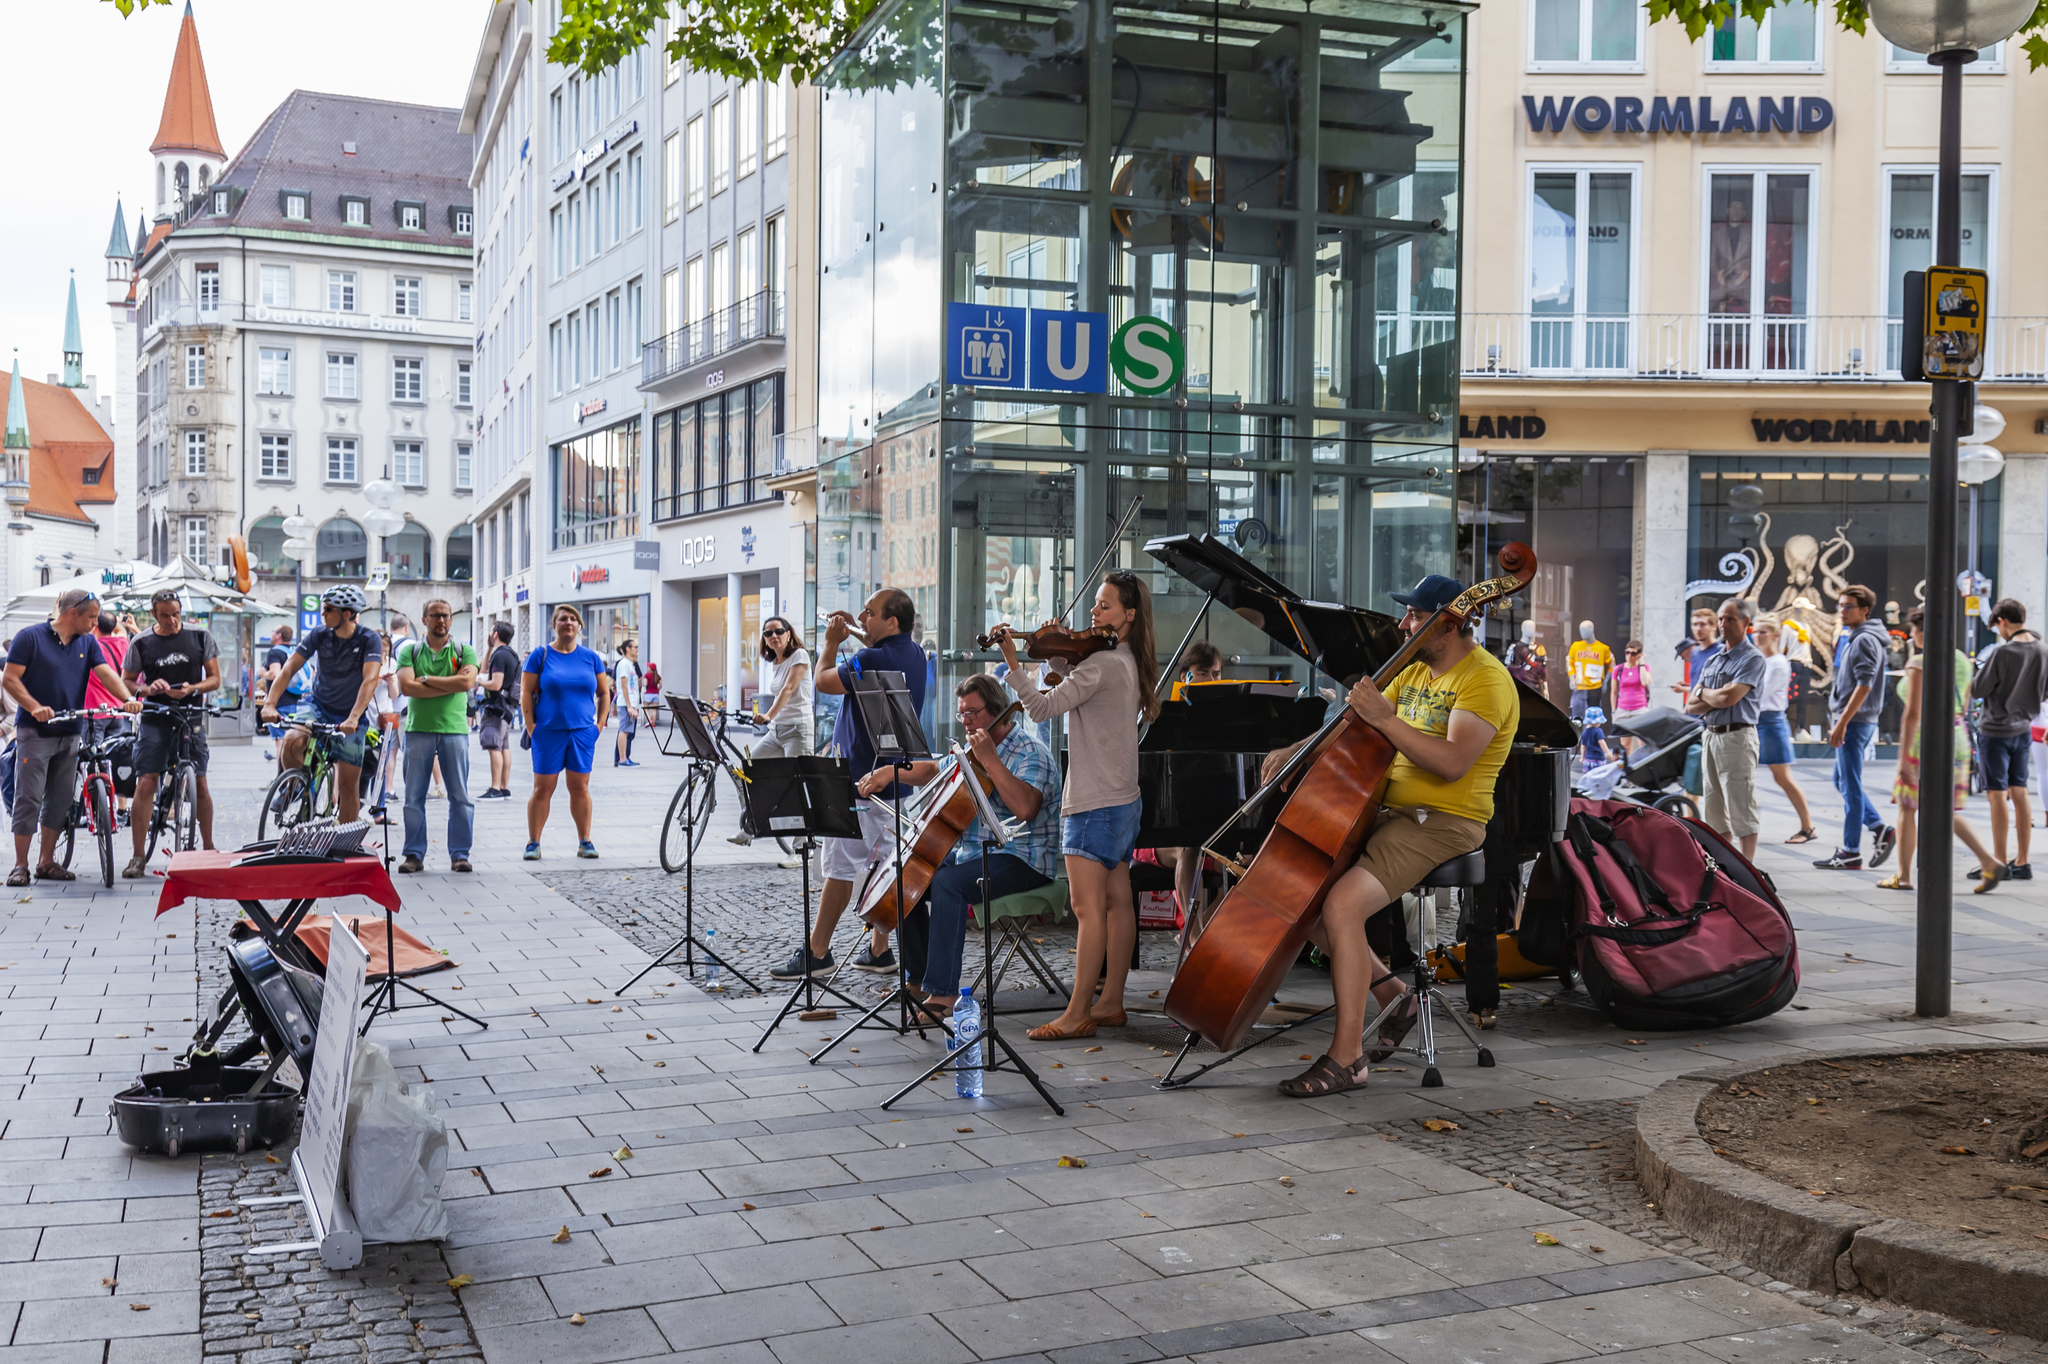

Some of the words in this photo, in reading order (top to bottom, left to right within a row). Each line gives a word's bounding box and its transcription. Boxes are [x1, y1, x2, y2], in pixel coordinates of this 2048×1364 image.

[1522, 95, 1834, 133] WORMLAND
[255, 305, 361, 329] Deutsche
[369, 313, 423, 333] Bank
[1047, 320, 1090, 380] U
[1124, 323, 1173, 388] S
[635, 551, 659, 560] IQOS
[681, 535, 715, 567] IQOS
[580, 564, 608, 583] vodafone
[304, 595, 318, 611] S
[304, 614, 317, 629] U
[962, 1025, 979, 1033] SPA
